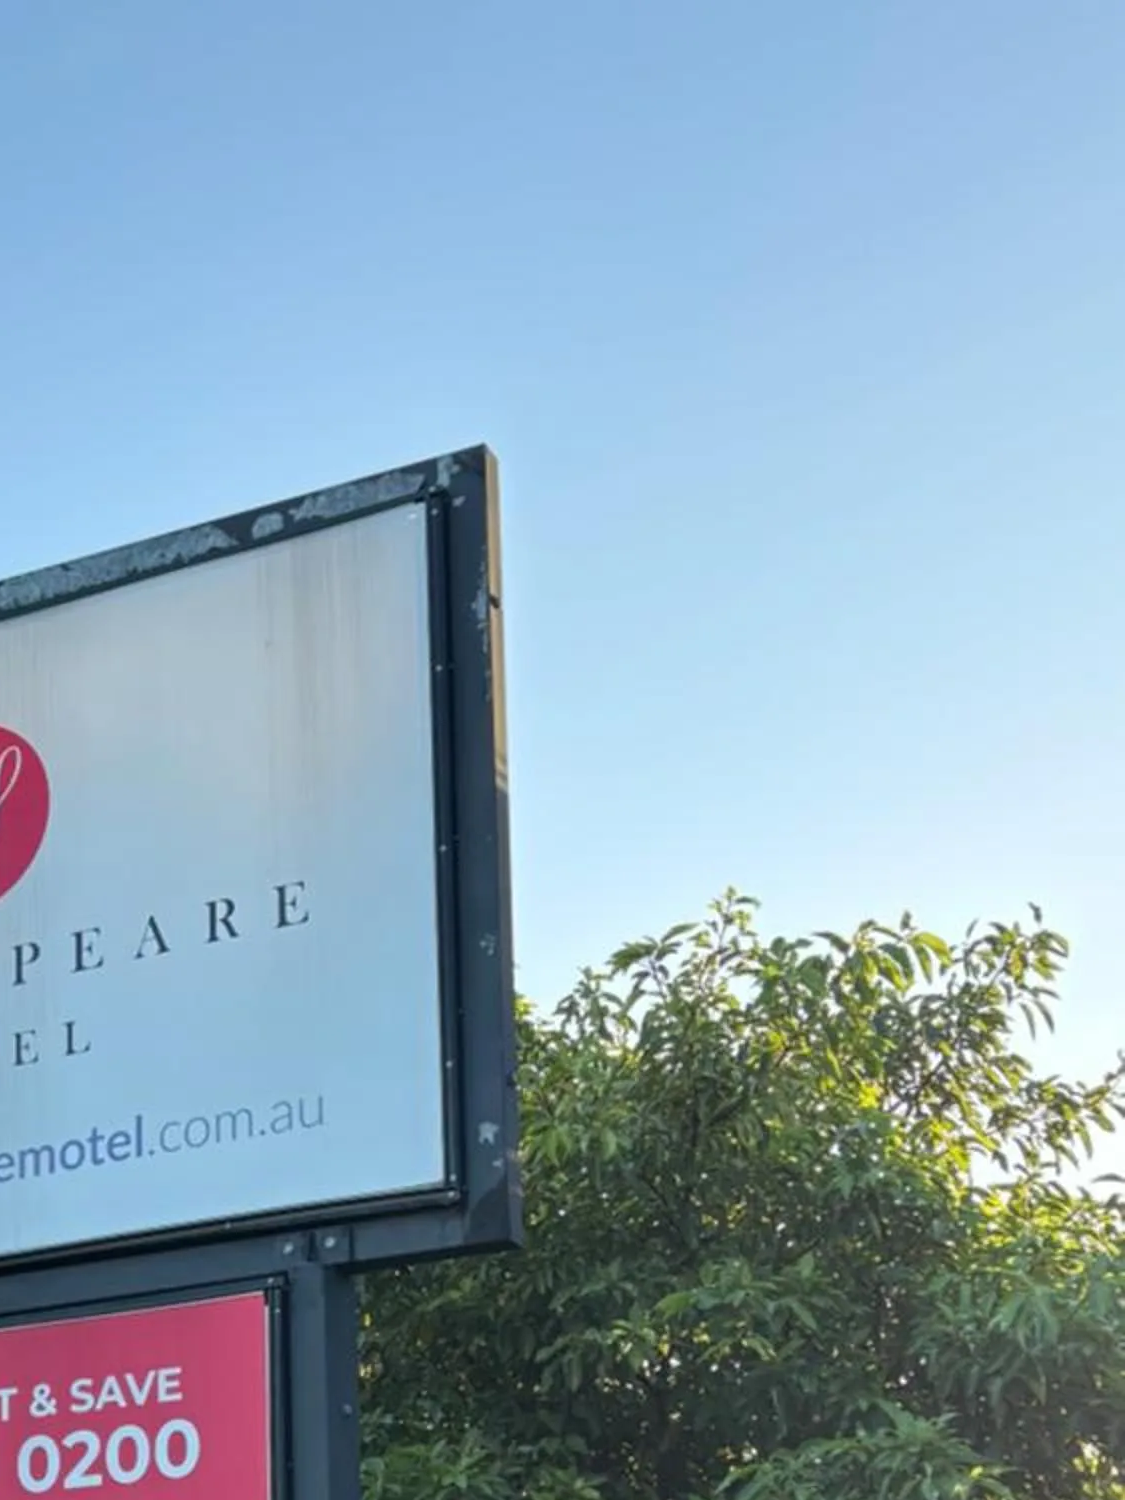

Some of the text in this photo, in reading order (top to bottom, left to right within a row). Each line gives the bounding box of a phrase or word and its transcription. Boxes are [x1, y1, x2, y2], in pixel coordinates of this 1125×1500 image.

[30, 1384, 57, 1417] &
[70, 1367, 183, 1412] SAVE
[17, 1419, 201, 1494] 0200
